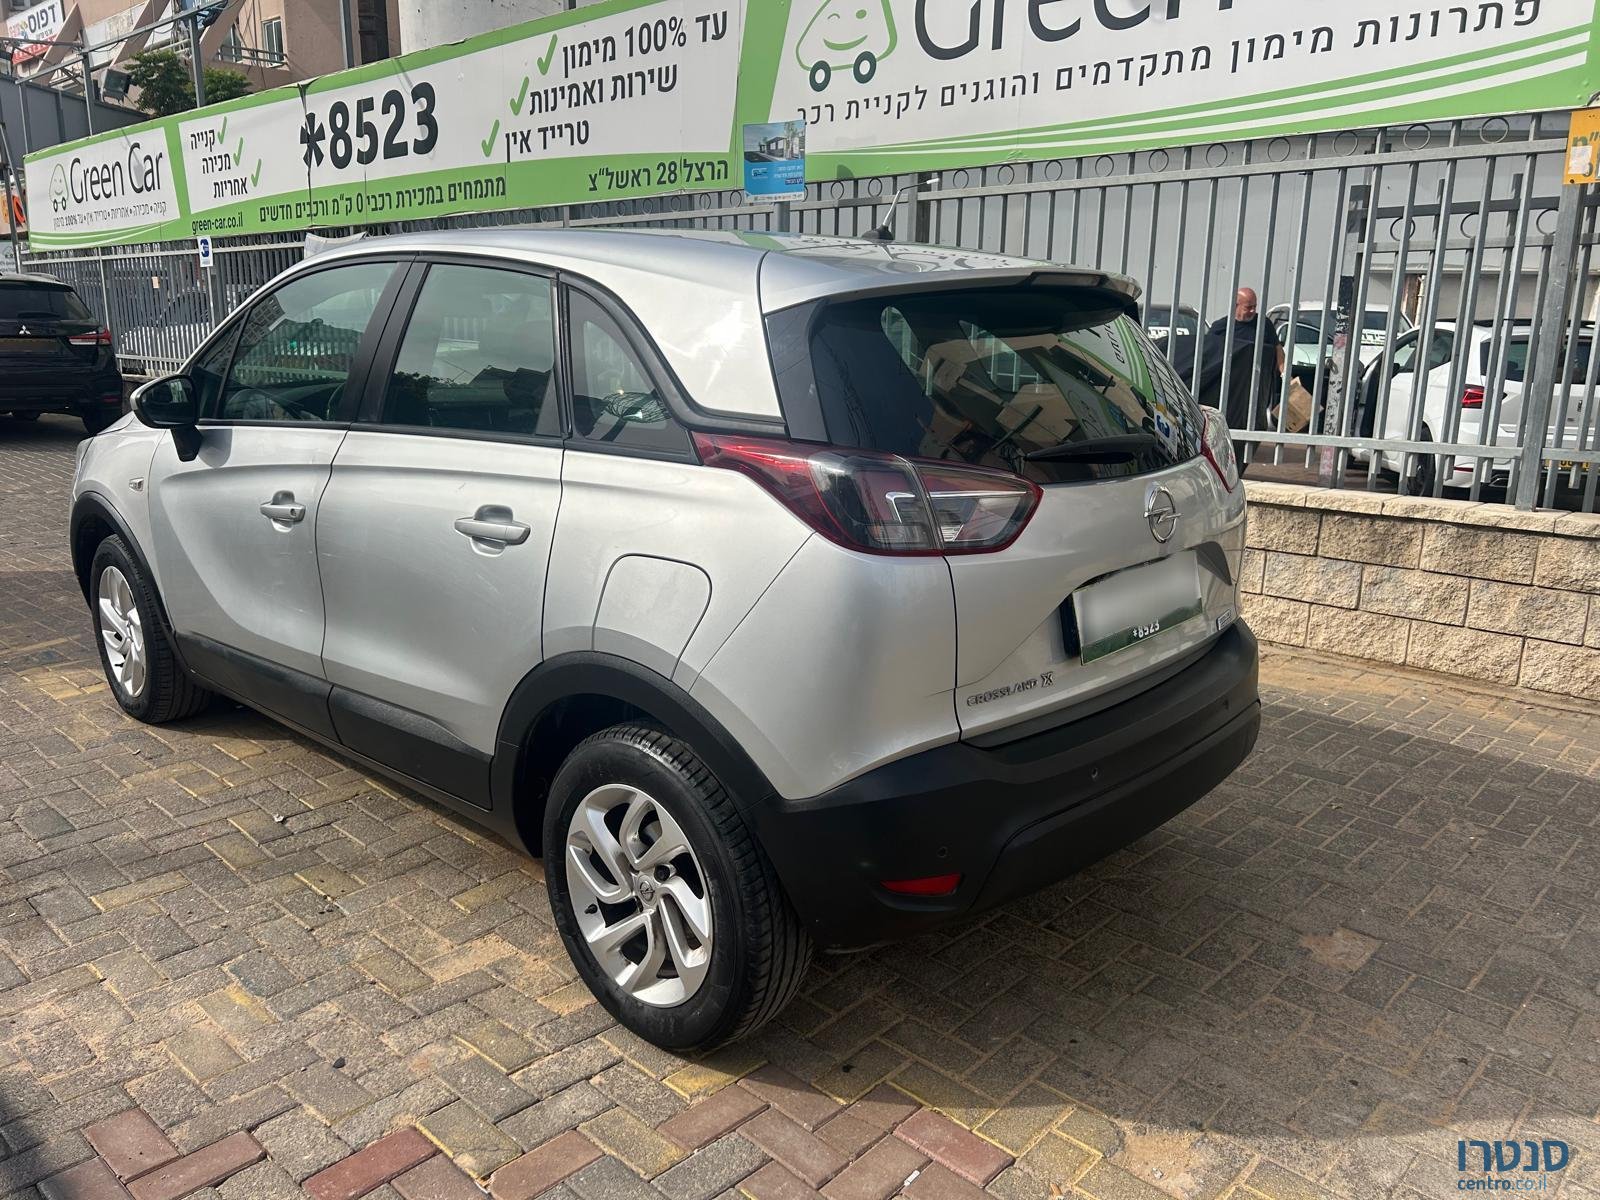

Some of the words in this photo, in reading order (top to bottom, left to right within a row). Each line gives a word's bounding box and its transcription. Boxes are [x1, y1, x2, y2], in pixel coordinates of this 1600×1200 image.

[624, 16, 687, 57] 100%
[695, 10, 728, 43] עד
[1354, 0, 1541, 48] פתרונות
[562, 35, 616, 78] מימון
[1231, 26, 1334, 73] מימון
[610, 64, 678, 101] שירות
[1056, 45, 1211, 90] מתקדמים
[529, 78, 604, 115] ואמינות
[845, 85, 927, 120] לקניית
[940, 71, 1039, 107] והוגנים
[190, 129, 216, 152] קנייה
[505, 129, 532, 163] אין
[537, 119, 590, 151] טרייד
[70, 157, 125, 204] Green
[128, 142, 162, 193] Car
[202, 153, 231, 174] מכירה
[656, 160, 678, 184] 28
[682, 158, 728, 182] הרצל
[213, 176, 248, 198] אחריות
[356, 193, 364, 213] 0
[367, 193, 393, 212] רכבי
[396, 184, 444, 209] במכירת
[448, 176, 506, 202] מתמחים
[192, 211, 244, 235] green-car.co.il
[259, 204, 293, 222] חדשים
[295, 198, 329, 219] ורכבים
[966, 678, 1037, 707] CROSSLAND
[1040, 671, 1054, 688] X
